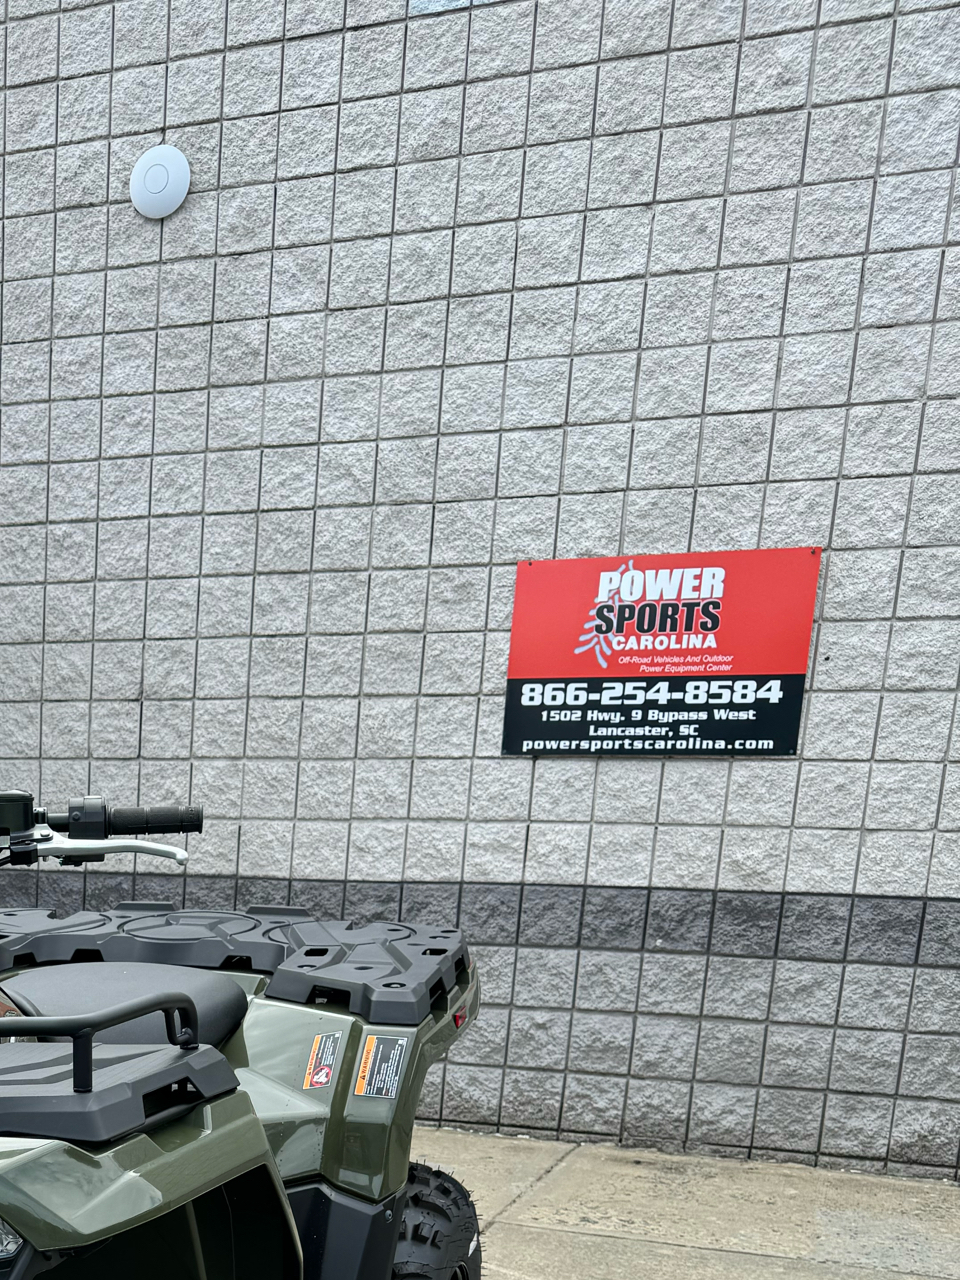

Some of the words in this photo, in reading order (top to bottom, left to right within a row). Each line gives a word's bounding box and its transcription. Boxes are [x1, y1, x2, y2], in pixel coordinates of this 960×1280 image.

[597, 567, 726, 603] POWER
[594, 600, 722, 635] SPORTS
[611, 633, 718, 651] CAROLINA
[618, 656, 652, 664] Off-Road
[653, 655, 685, 663] Vehicles
[685, 655, 701, 663] And
[702, 654, 734, 662] Outdoor
[639, 664, 664, 673] Power
[665, 664, 705, 674] Equipment
[706, 663, 733, 671] Center
[521, 680, 783, 706] 866-254-8584
[541, 709, 582, 721] 1502
[586, 709, 625, 723] Hwy.
[631, 709, 643, 721] 9
[647, 709, 708, 723] Bypass
[713, 709, 757, 720] West
[589, 725, 674, 738] Lancaster,
[679, 724, 699, 736] SC
[522, 737, 774, 752] powersportscarolina.com
